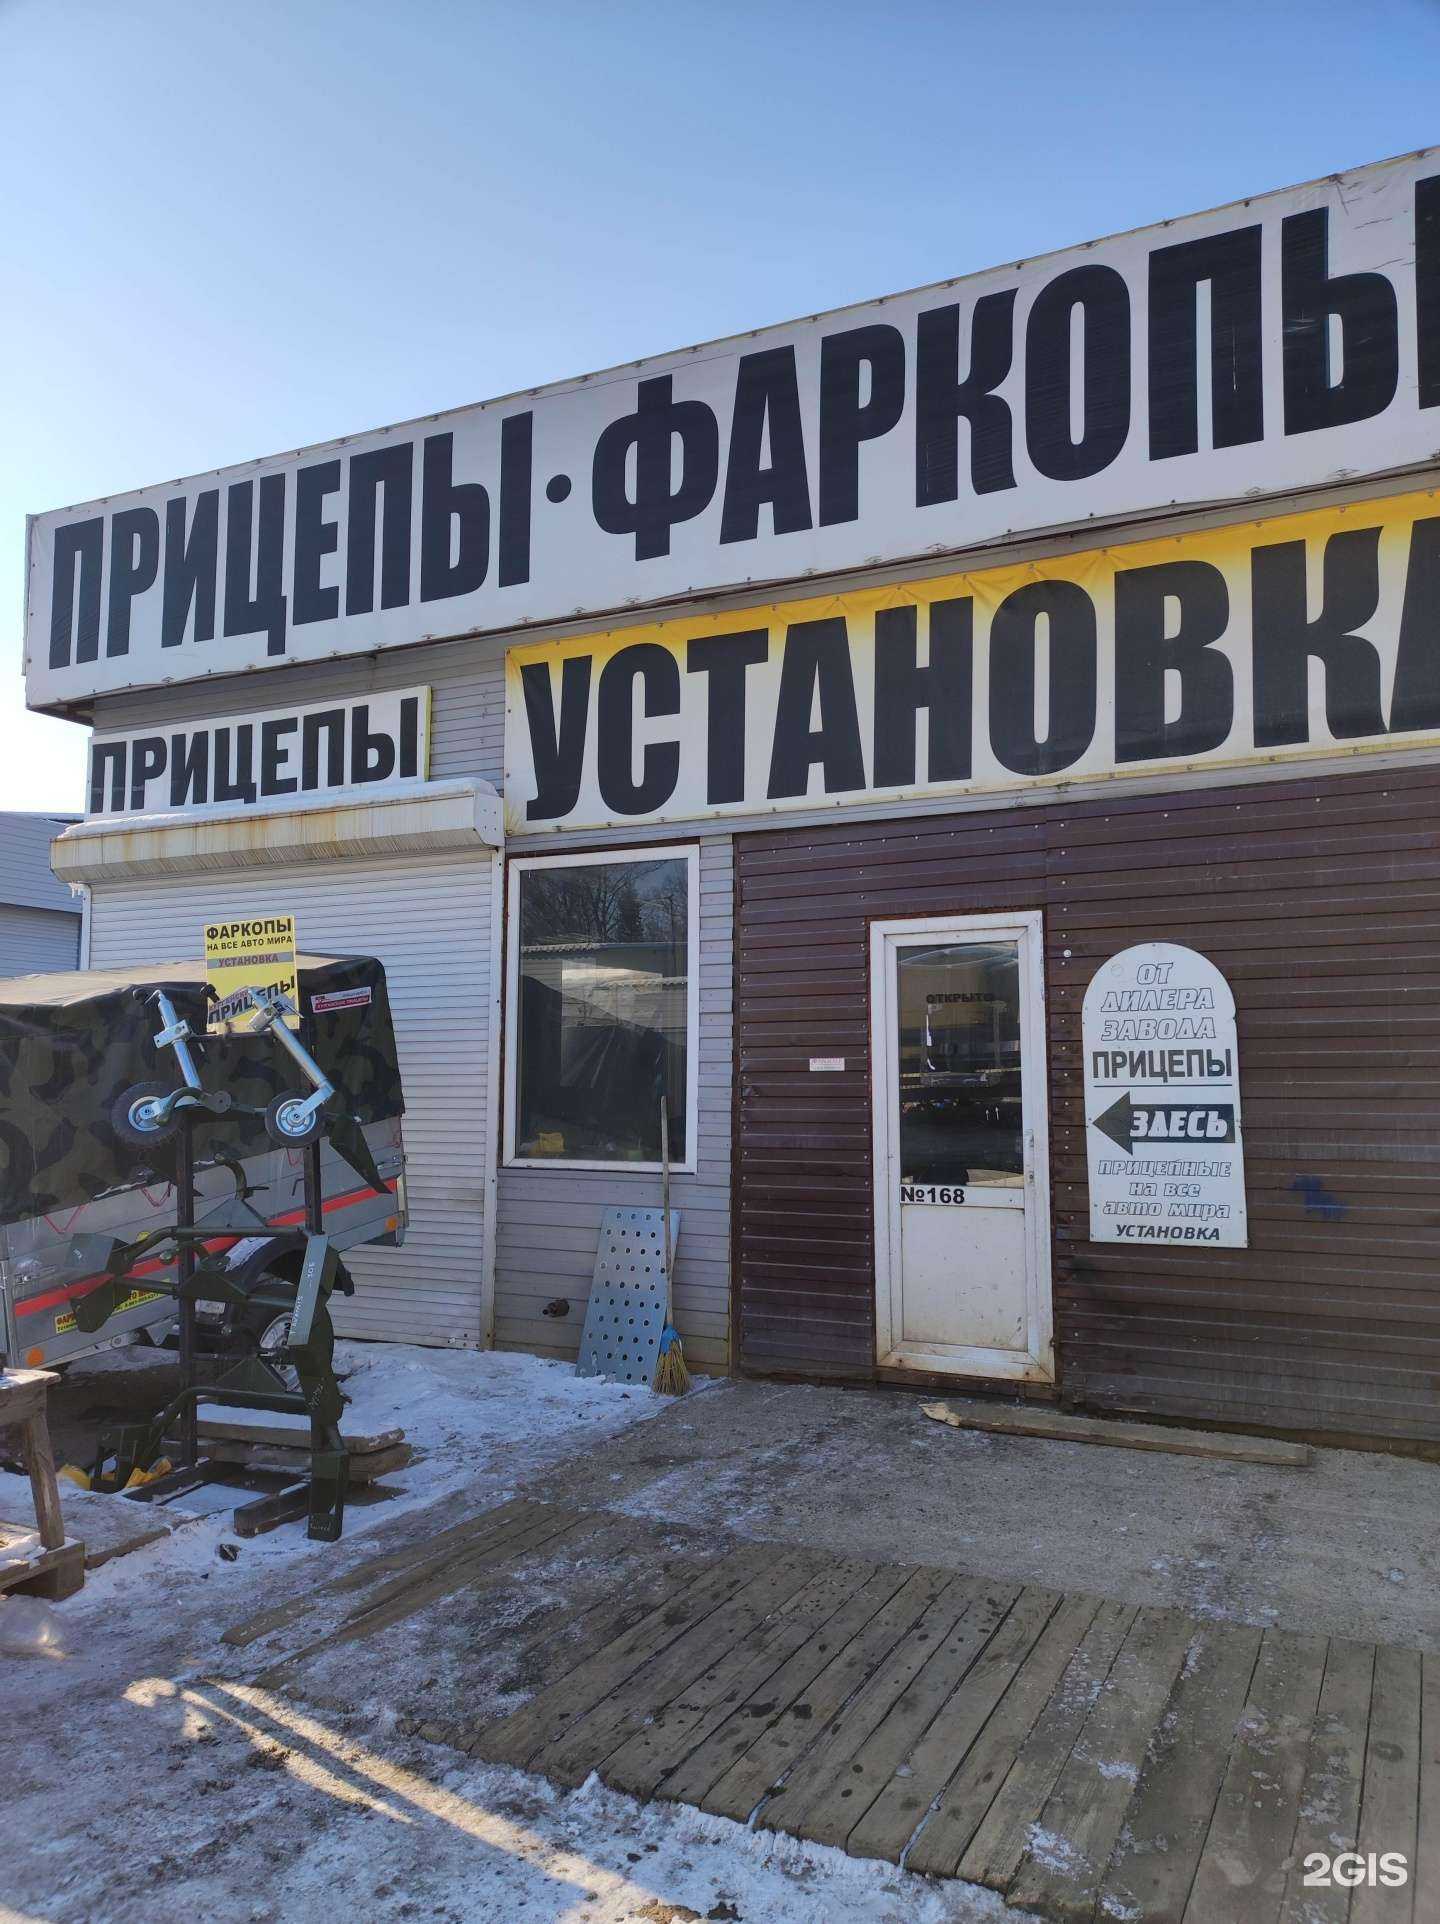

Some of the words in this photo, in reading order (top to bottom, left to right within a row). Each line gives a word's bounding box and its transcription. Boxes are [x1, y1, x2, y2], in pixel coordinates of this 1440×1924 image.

[49, 411, 533, 656] ПРИЦЕПЫ
[592, 174, 1440, 561] ФАРКОПЫ
[89, 696, 418, 814] ПРИЦЕПЫ
[206, 918, 292, 940] ФАРКОПЫ
[207, 943, 220, 952] НА
[221, 941, 239, 950] ВСЕ
[240, 938, 265, 948] АВТО
[267, 935, 293, 945] МИРА
[218, 953, 280, 968] УСТАНОВКА
[1137, 962, 1174, 985] ОТ
[1100, 987, 1215, 1012] ДИЛЕРА
[1101, 1017, 1216, 1041] ЗАВОДА
[1092, 1049, 1232, 1083] ПРИЦЕПЫ
[1130, 1110, 1228, 1138] ЗДЕСЬ
[1098, 1159, 1232, 1177] ПРИЦЕПНЫЕ
[900, 1185, 965, 1205] №168
[1129, 1182, 1158, 1196] на
[1163, 1183, 1201, 1197] все
[1103, 1200, 1162, 1216] авто
[1168, 1203, 1231, 1221] мира
[1116, 1224, 1221, 1240] УСТАНОВКА
